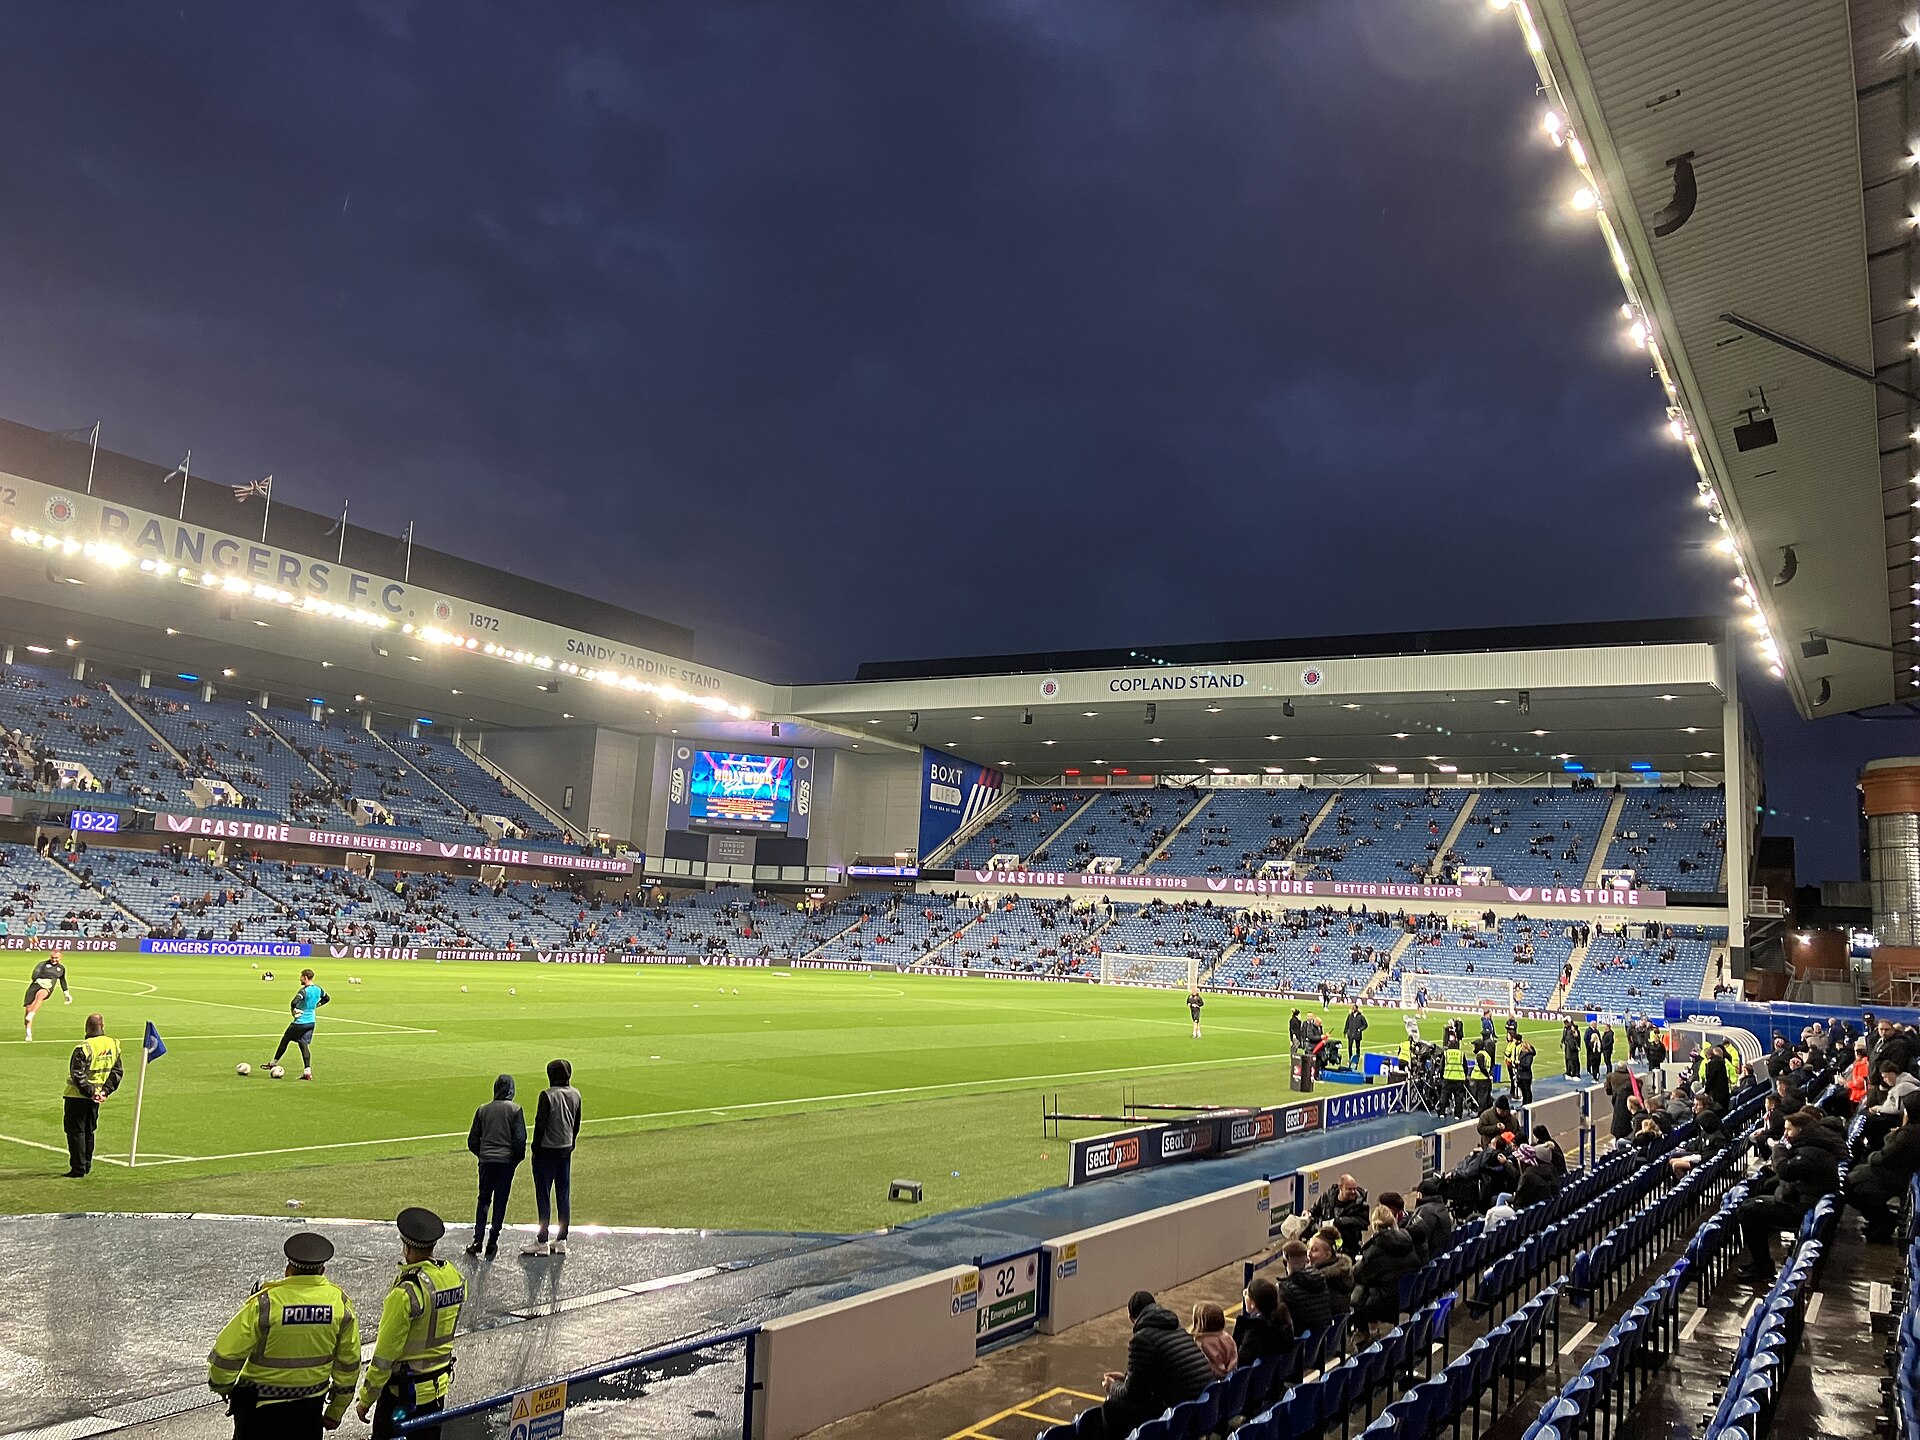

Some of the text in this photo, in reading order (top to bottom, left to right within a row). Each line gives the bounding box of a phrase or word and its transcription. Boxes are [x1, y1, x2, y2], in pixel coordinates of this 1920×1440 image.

[349, 573, 415, 617] F.C.
[469, 612, 500, 632] 1872
[566, 638, 721, 690] SANDY JARDINE STAND
[1109, 673, 1245, 693] COPLAND STAND
[930, 763, 963, 785] BOXT
[670, 767, 685, 804] SEKO
[936, 786, 956, 803] LIFE
[797, 780, 811, 816] SEKO
[73, 813, 117, 832] 19:22
[201, 818, 423, 852] CASTORE BETTER NEVER STOPS
[463, 845, 627, 872] CASTORE BETTER NEVER STOPS
[997, 871, 1188, 888] CASTORE BETTER NEVER STOPS
[1233, 879, 1639, 905] CASTORE BETTER NEVER STOPS CASTORE
[76, 940, 117, 951] STOPS
[151, 941, 301, 956] RANGERS FOOTBALL CLUB
[353, 946, 521, 962] CASTORE BETTER NEVER STOPS
[555, 953, 687, 965] CASTORE BETTER NEVER STOPS
[712, 956, 771, 967] CASTORE
[790, 960, 820, 969] BETTER
[1687, 1014, 1722, 1026] SEKO
[1345, 1091, 1391, 1118] CASTORE
[1284, 1111, 1300, 1129] seat
[1233, 1123, 1250, 1138] seat
[1165, 1131, 1185, 1152] seat
[1088, 1139, 1138, 1169] seat sub
[996, 1266, 1016, 1297] 32
[436, 1288, 463, 1306] POLICE
[284, 1305, 331, 1323] POLICE
[991, 1303, 1017, 1321] Emergency
[538, 1386, 559, 1401] KEEP
[535, 1398, 561, 1414] CLEAR
